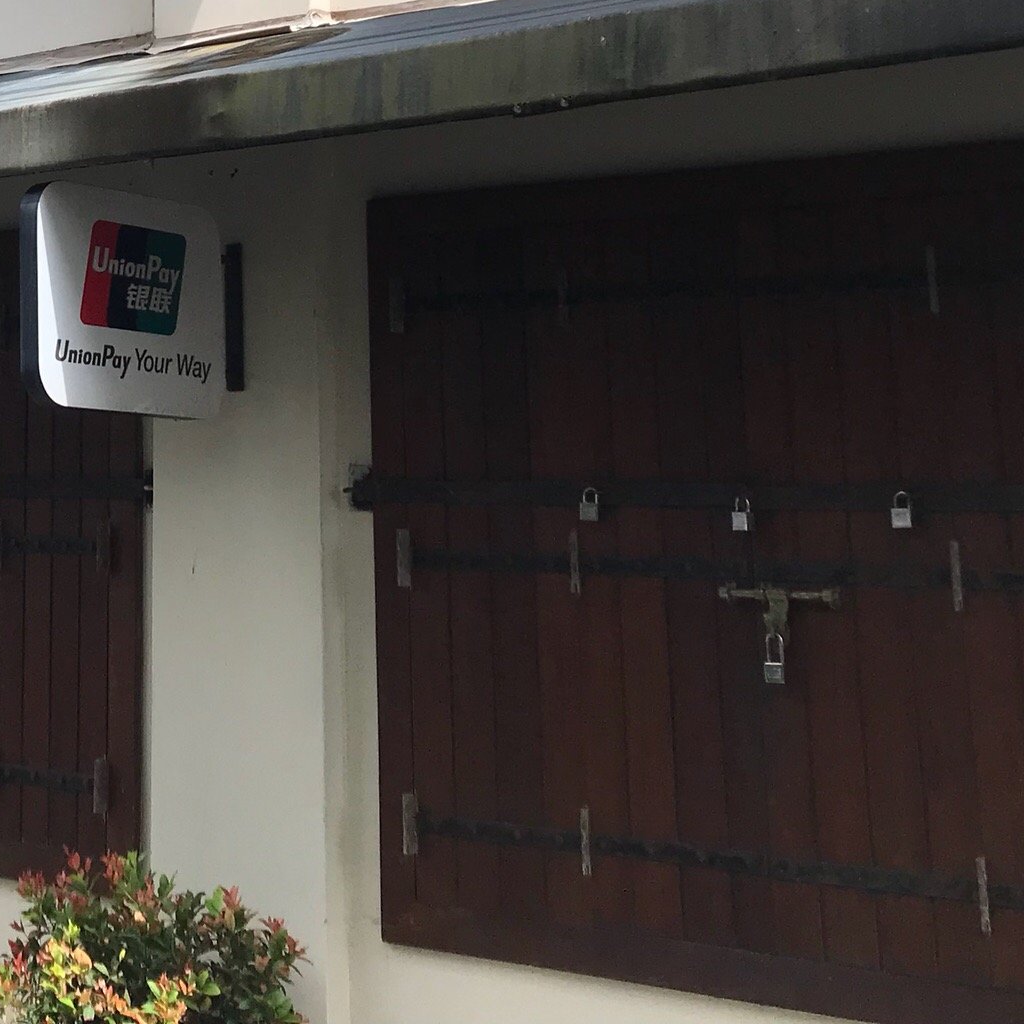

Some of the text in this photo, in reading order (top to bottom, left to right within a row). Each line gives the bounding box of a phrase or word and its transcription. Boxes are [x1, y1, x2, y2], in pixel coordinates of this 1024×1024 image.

[92, 245, 180, 293] UnionPay
[126, 283, 173, 314] 银联
[55, 339, 212, 384] UnionPay Your Way
